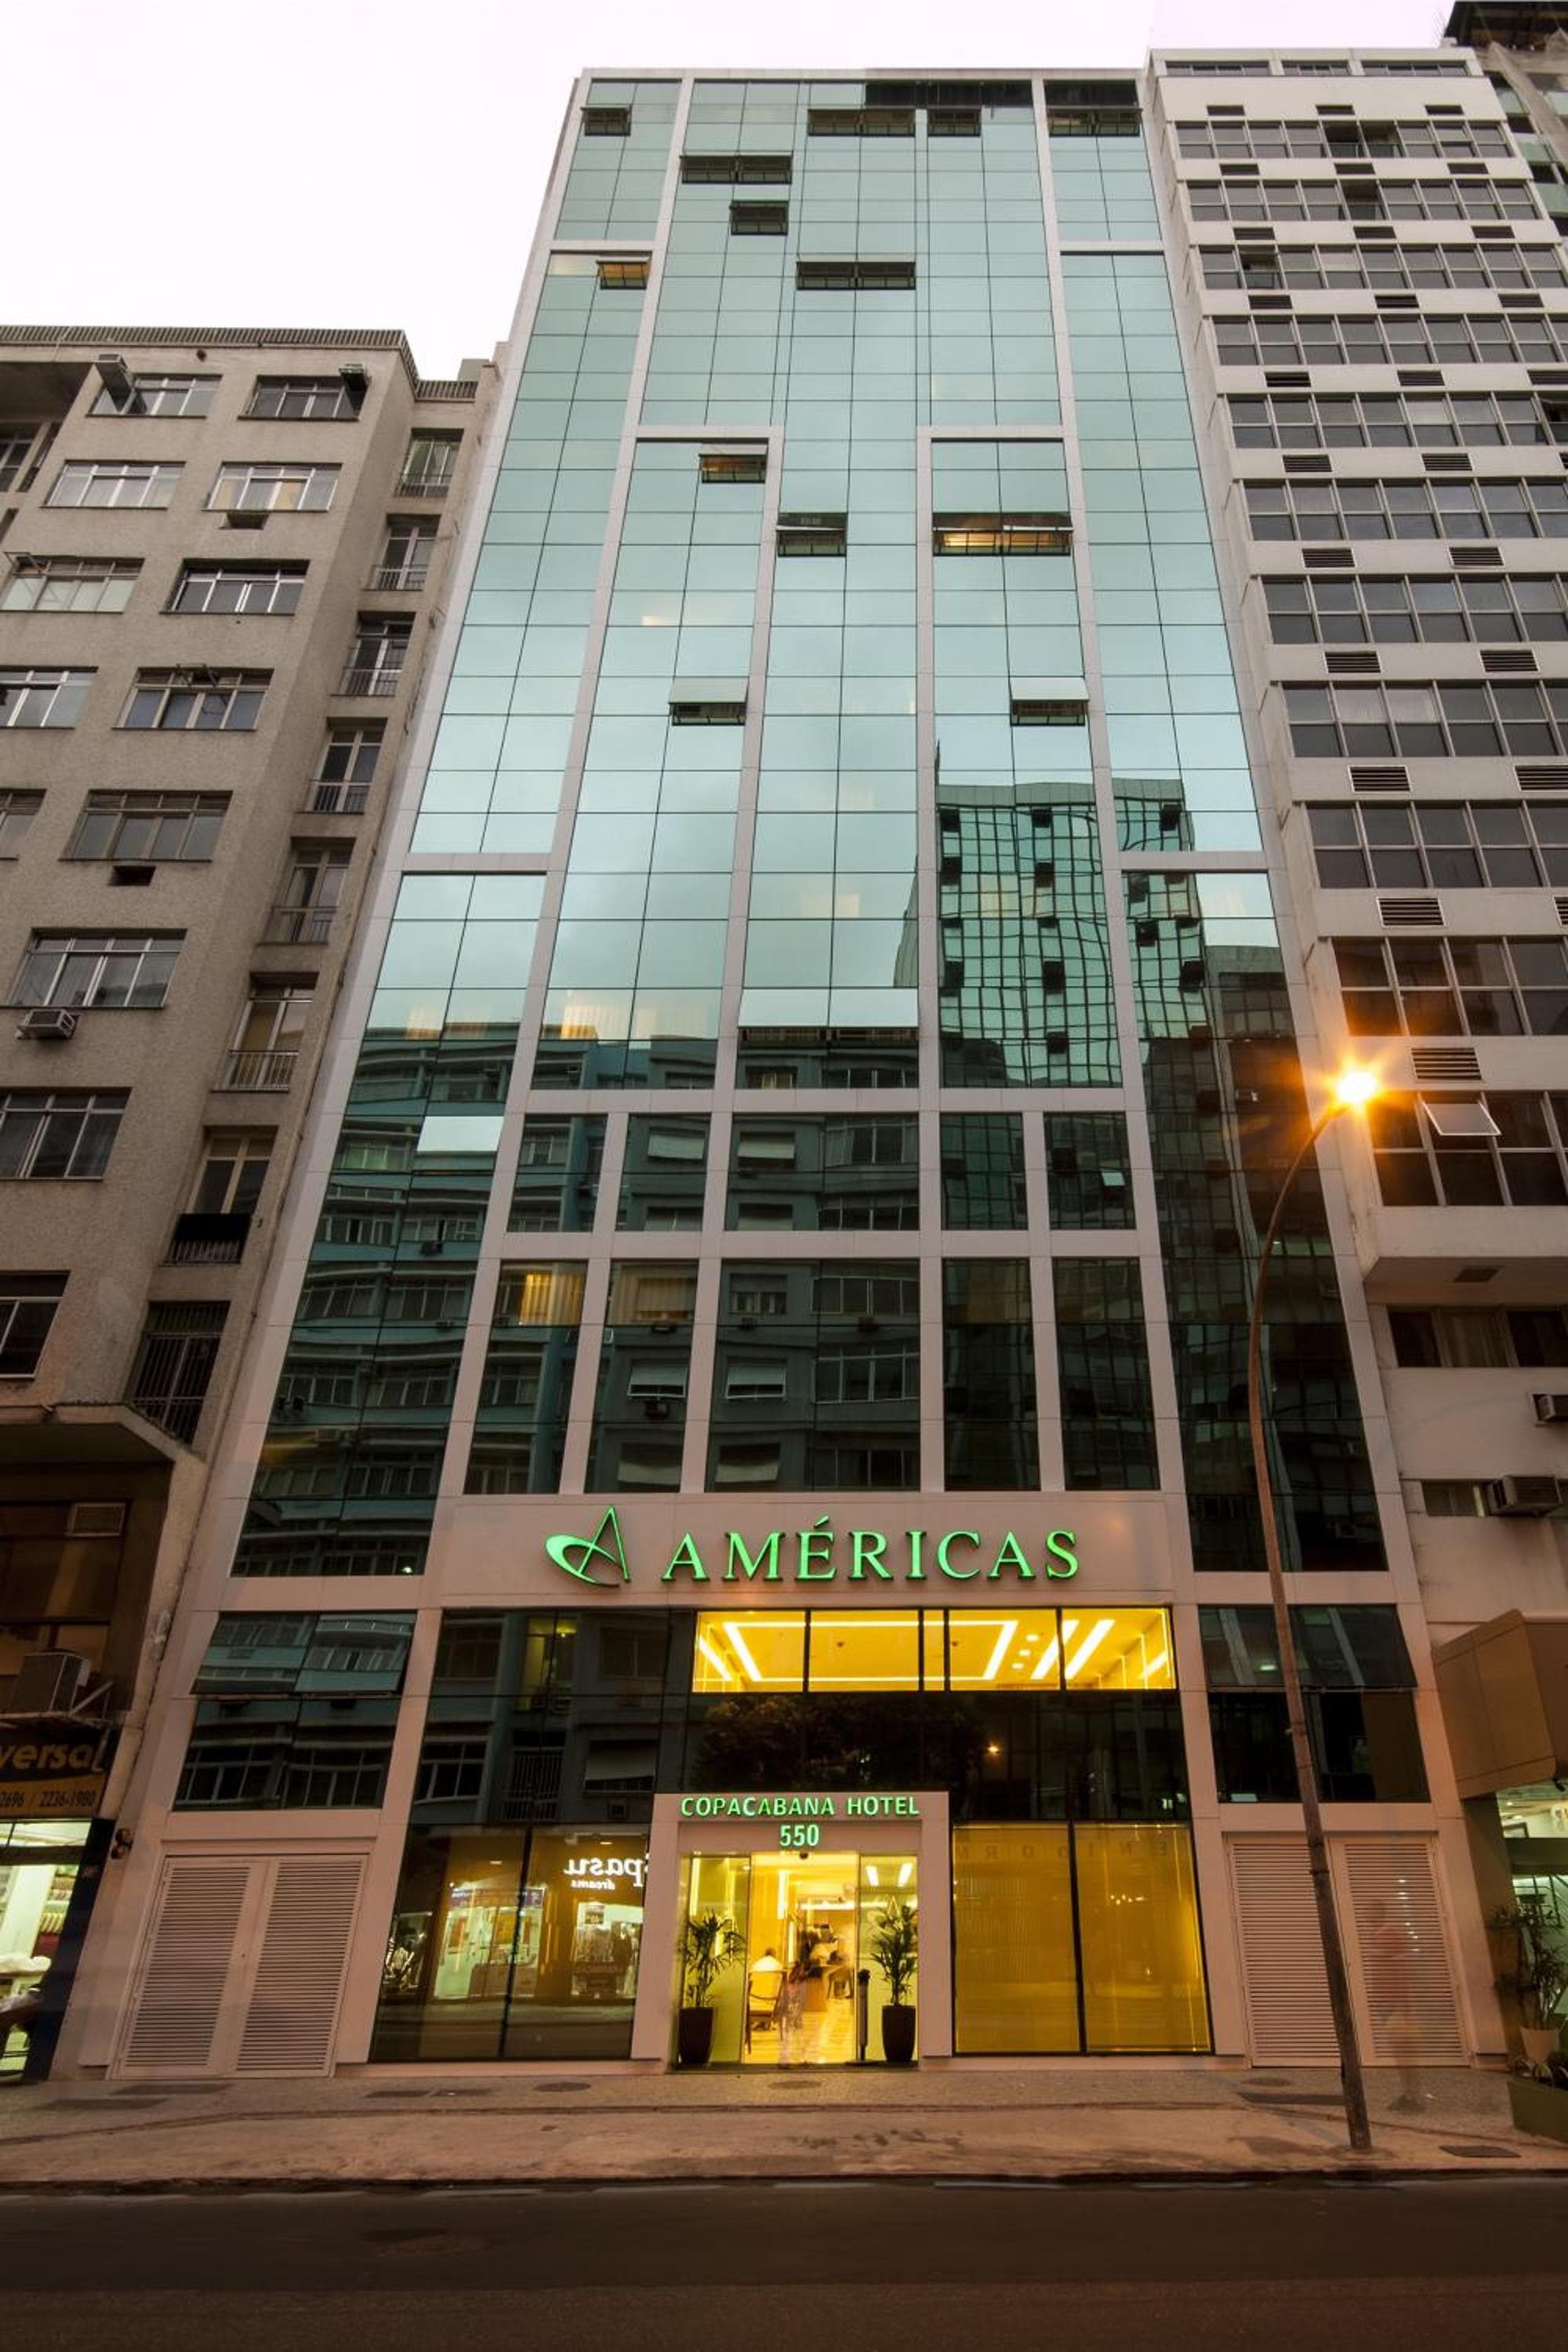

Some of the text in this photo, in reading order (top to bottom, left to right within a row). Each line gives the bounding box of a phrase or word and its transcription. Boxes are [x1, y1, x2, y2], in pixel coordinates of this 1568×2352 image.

[661, 1514, 1080, 1583] AMÉRICAS
[681, 1795, 920, 1817] COPACABANA HOTEL
[779, 1824, 820, 1847] 550
